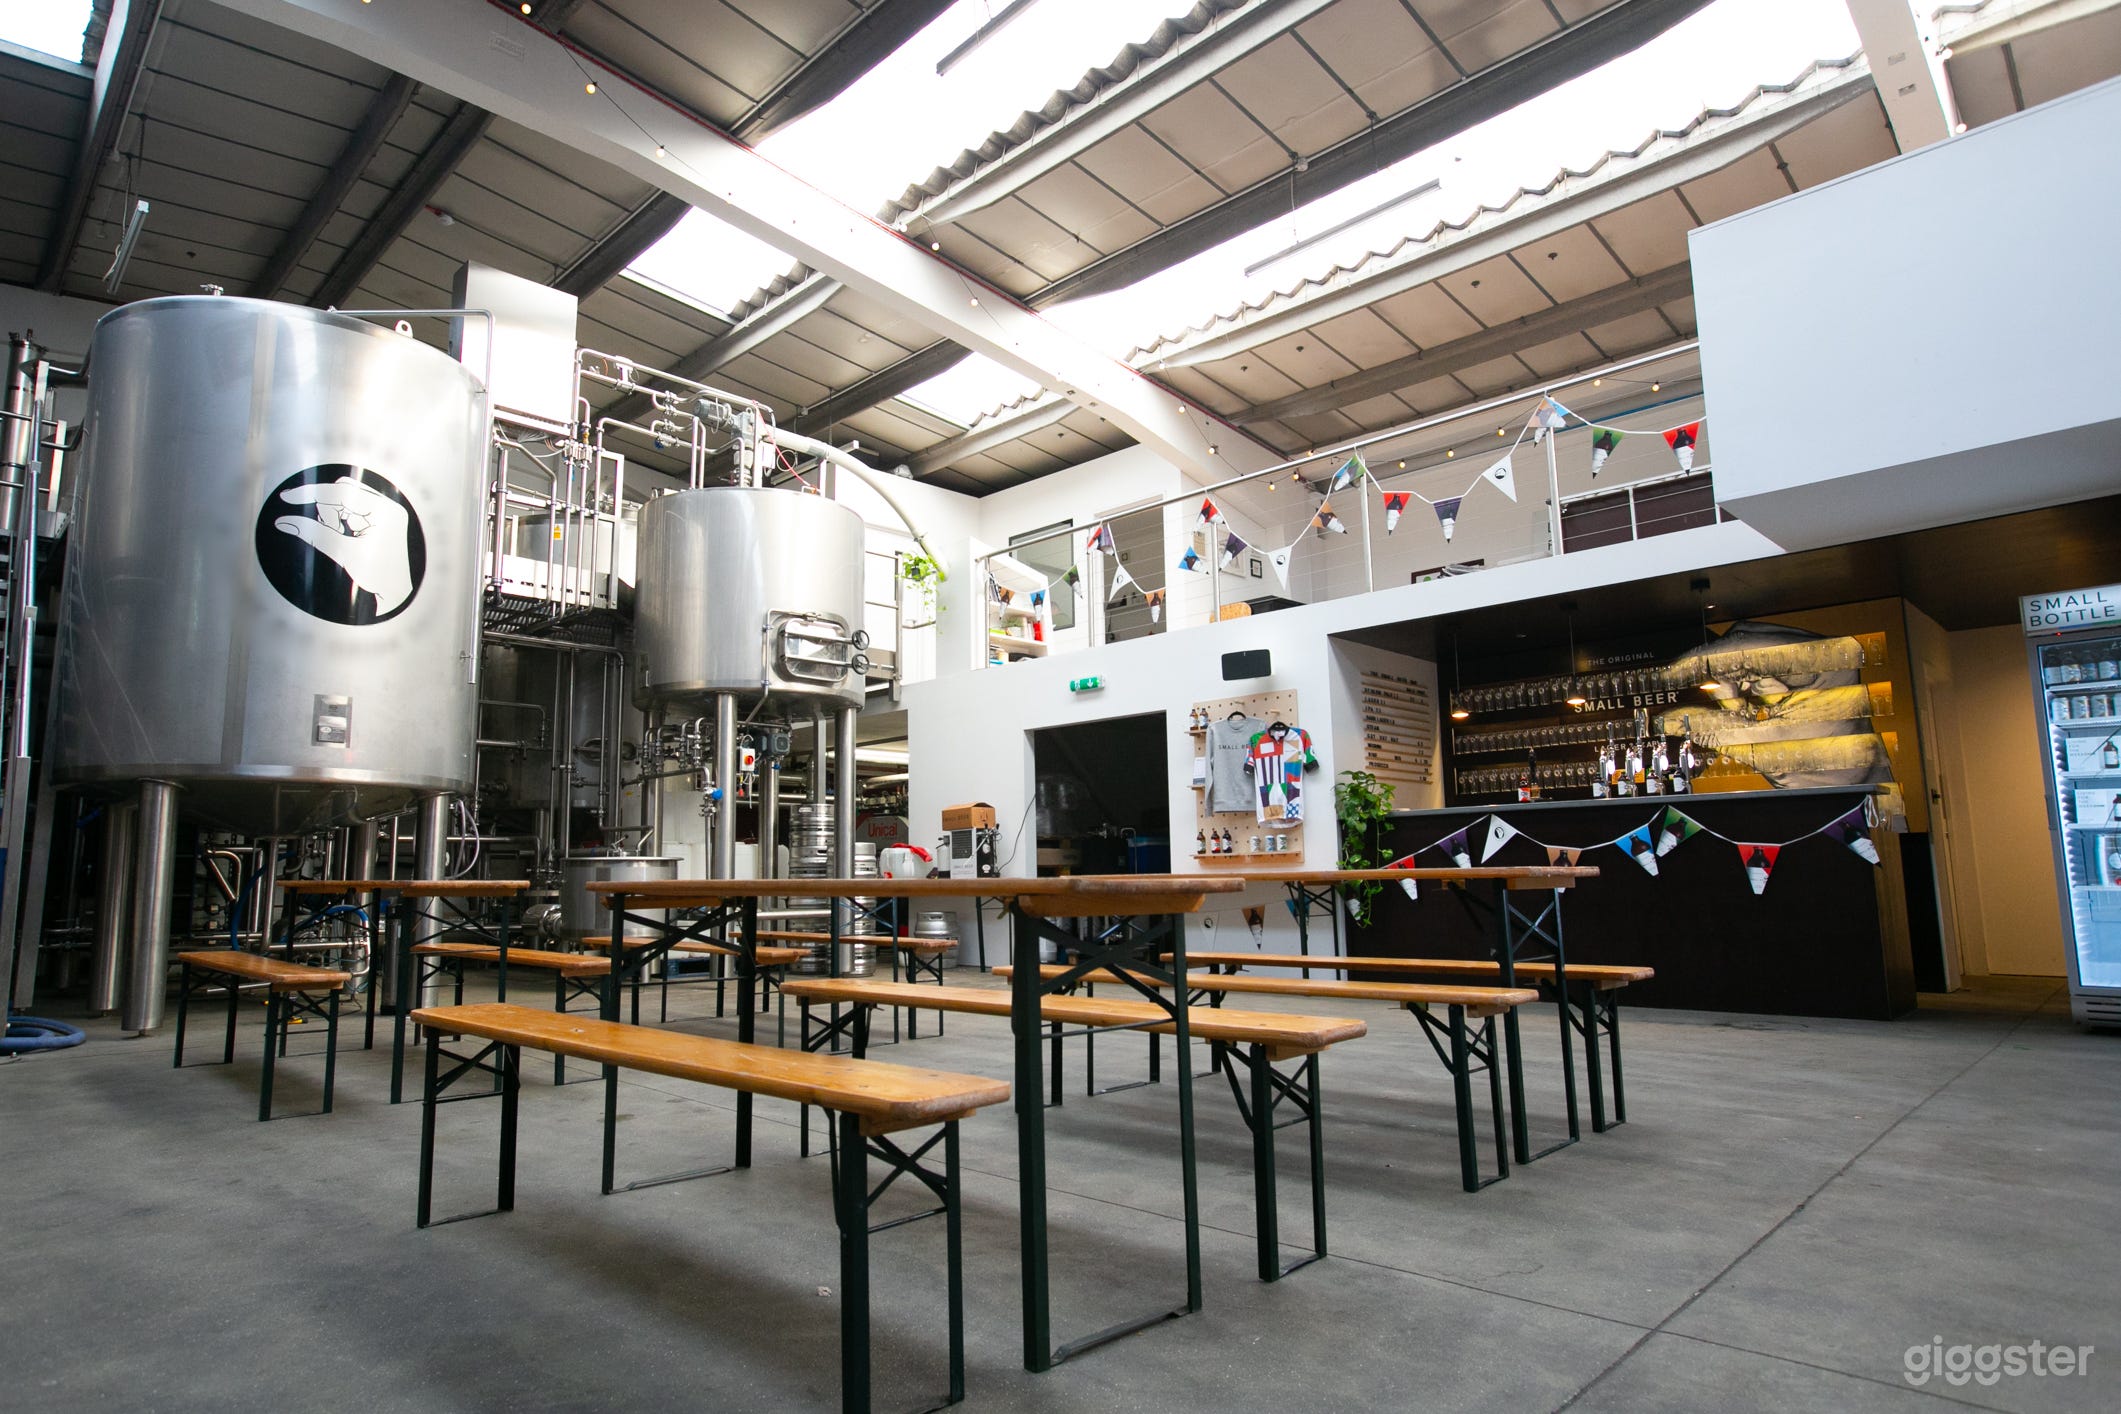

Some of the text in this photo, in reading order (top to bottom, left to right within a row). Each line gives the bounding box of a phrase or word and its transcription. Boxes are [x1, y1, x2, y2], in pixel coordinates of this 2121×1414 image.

[2030, 592, 2107, 612] SMALL
[2030, 605, 2116, 627] BOTTLE
[1607, 652, 1654, 664] ORIGINAL
[1574, 691, 1678, 713] SMALL BEER
[868, 822, 898, 838] Unical
